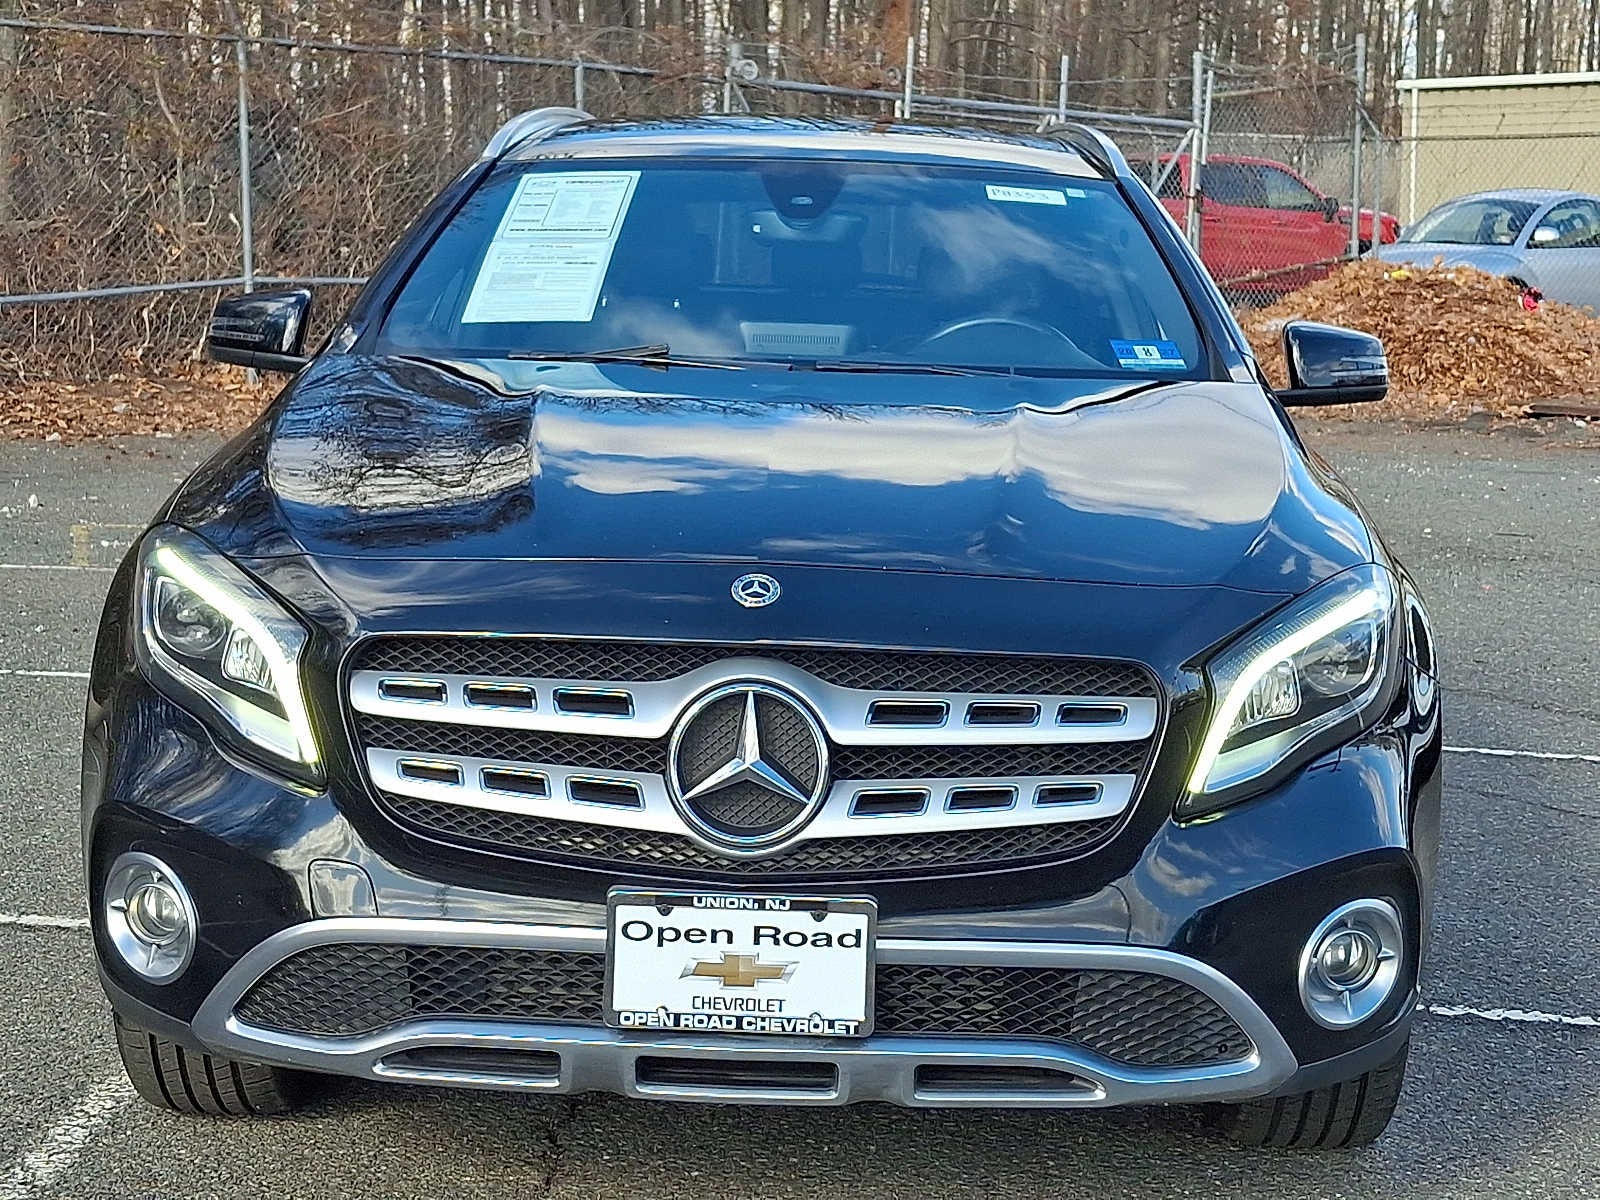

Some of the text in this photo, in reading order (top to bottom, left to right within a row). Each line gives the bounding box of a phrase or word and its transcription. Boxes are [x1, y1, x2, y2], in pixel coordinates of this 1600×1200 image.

[765, 898, 791, 910] NJ
[621, 920, 861, 948] Open Road
[692, 996, 786, 1012] CHEVROLET
[619, 1011, 859, 1035] OPEN ROAD CHEVROLET
